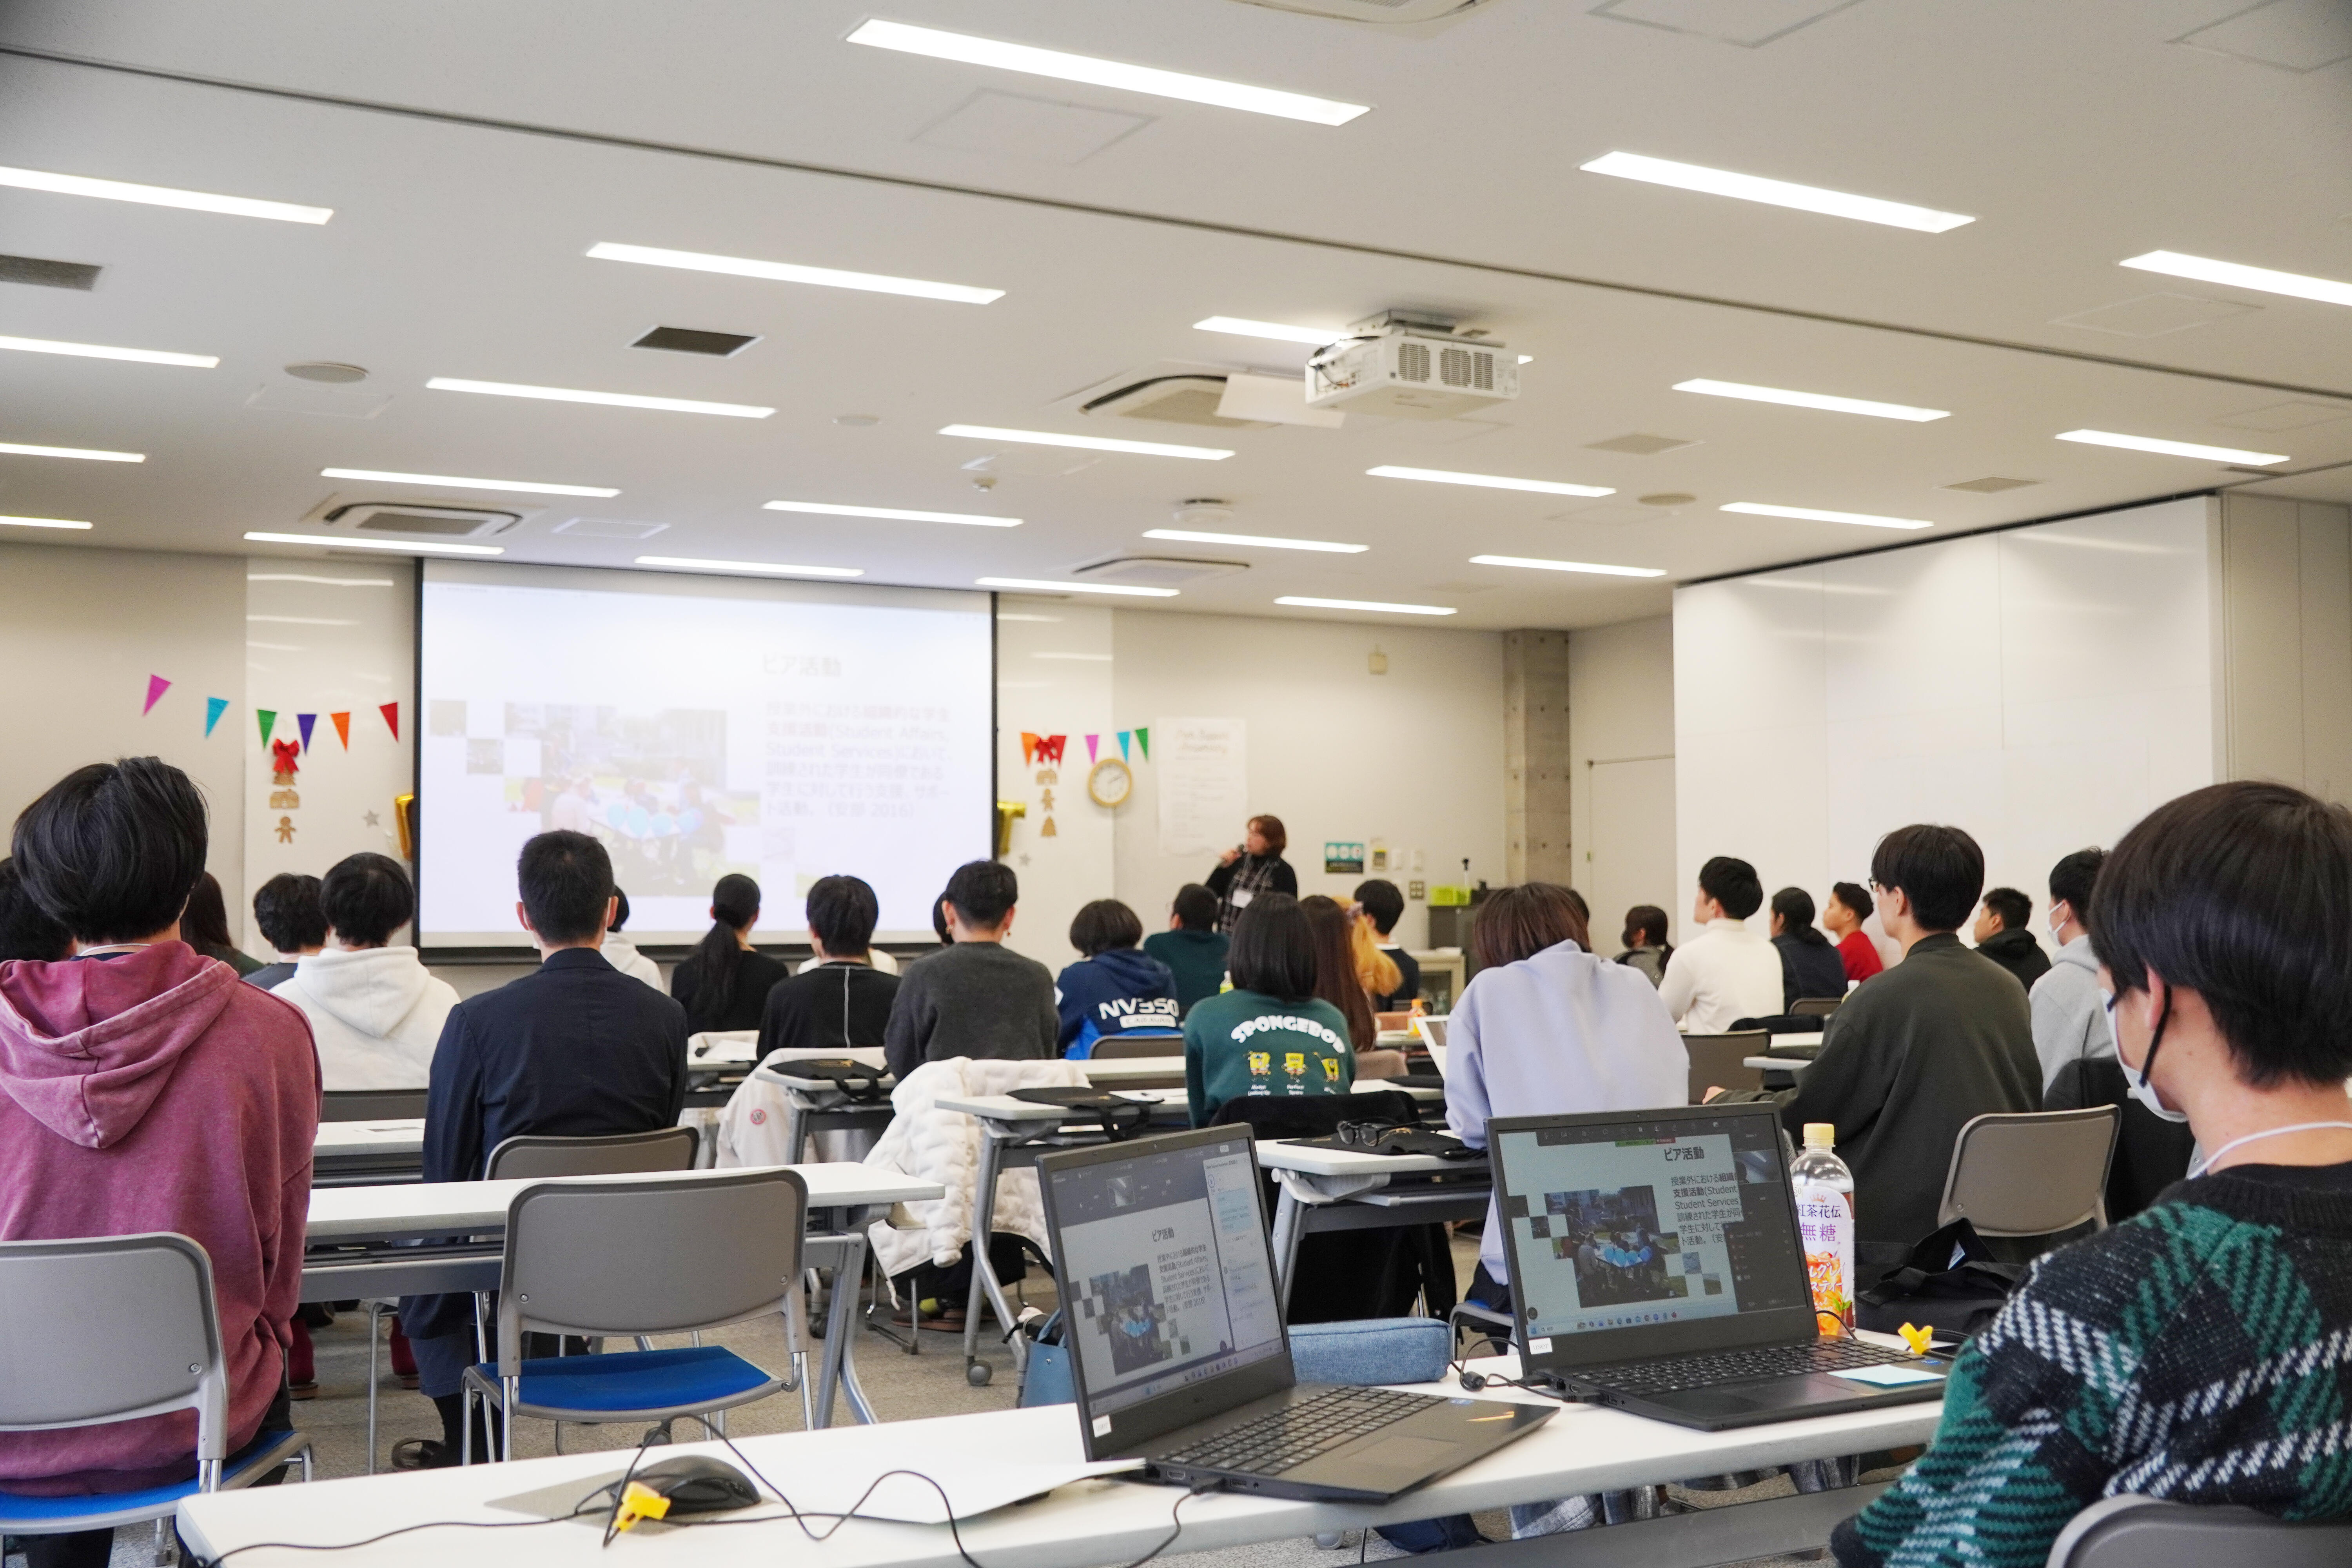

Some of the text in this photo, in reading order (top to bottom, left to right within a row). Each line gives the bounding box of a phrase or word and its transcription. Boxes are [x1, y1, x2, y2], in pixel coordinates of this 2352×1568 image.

[1664, 1146, 1704, 1161] ピア活動
[1671, 1172, 1737, 1186] 授業外における組織
[1675, 1198, 1739, 1210] Student Services
[1797, 1203, 1842, 1218] 紅茶花伝
[1679, 1222, 1723, 1234] 学生に対して
[1800, 1222, 1836, 1242] 無糖
